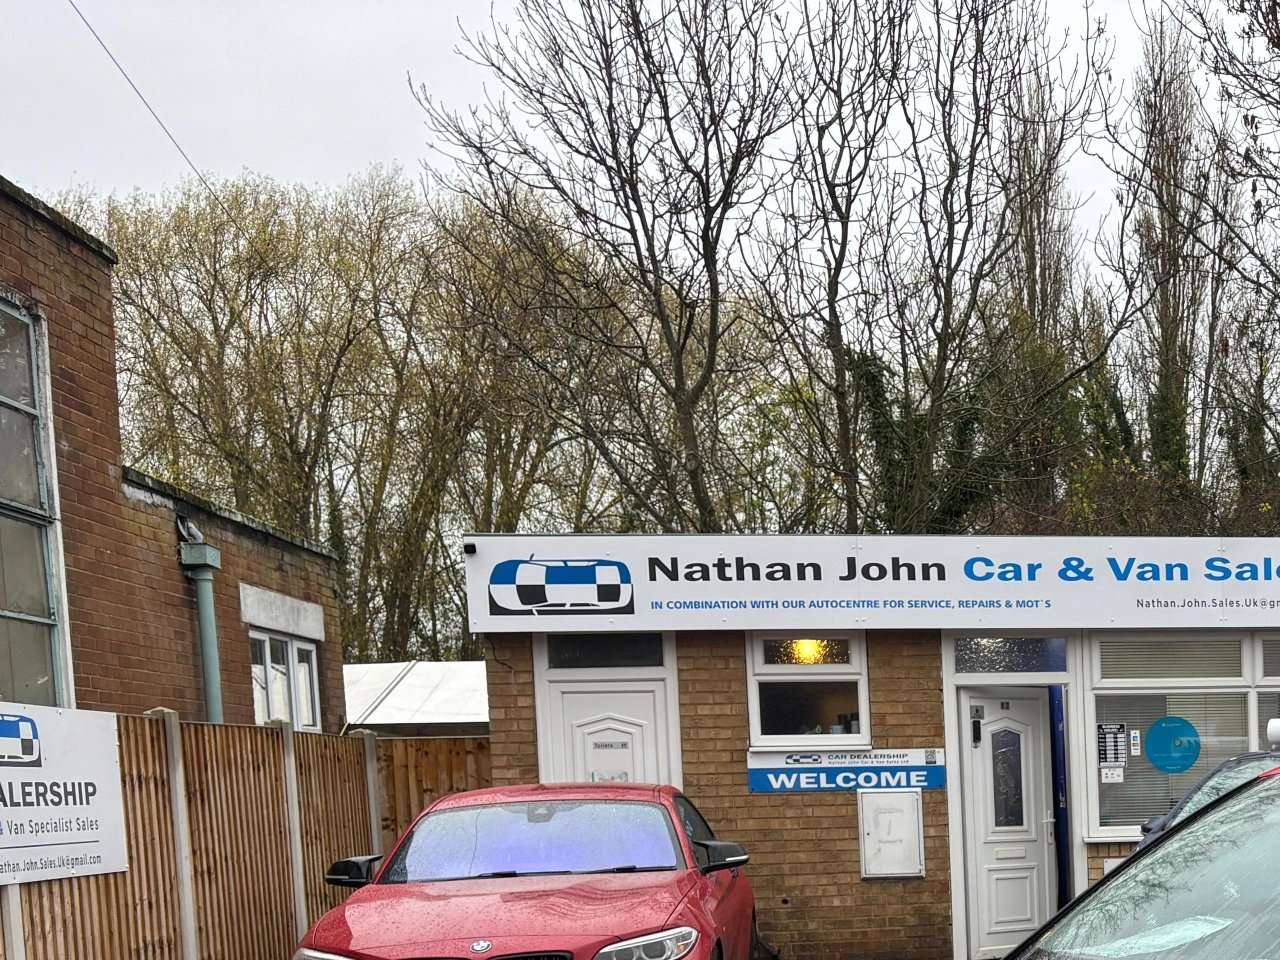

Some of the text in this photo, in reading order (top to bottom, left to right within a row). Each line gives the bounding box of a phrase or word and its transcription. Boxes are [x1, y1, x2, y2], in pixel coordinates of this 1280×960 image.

[648, 556, 822, 582] Nathan
[839, 556, 947, 582] John
[963, 556, 1042, 582] Car
[1057, 556, 1094, 582] &
[1107, 557, 1189, 581] Van
[650, 600, 663, 610] IN
[667, 600, 746, 610] COMBINATION
[750, 600, 779, 609] WITH
[782, 600, 805, 609] OUR
[808, 600, 880, 609] AUTOCENTRE
[883, 599, 906, 609] FOR
[908, 599, 956, 610] SERVICE,
[958, 599, 1001, 608] REPAIRS
[1005, 599, 1013, 608] &
[767, 771, 928, 788] WELCOME
[7, 817, 99, 837] Van Specialist Sales
